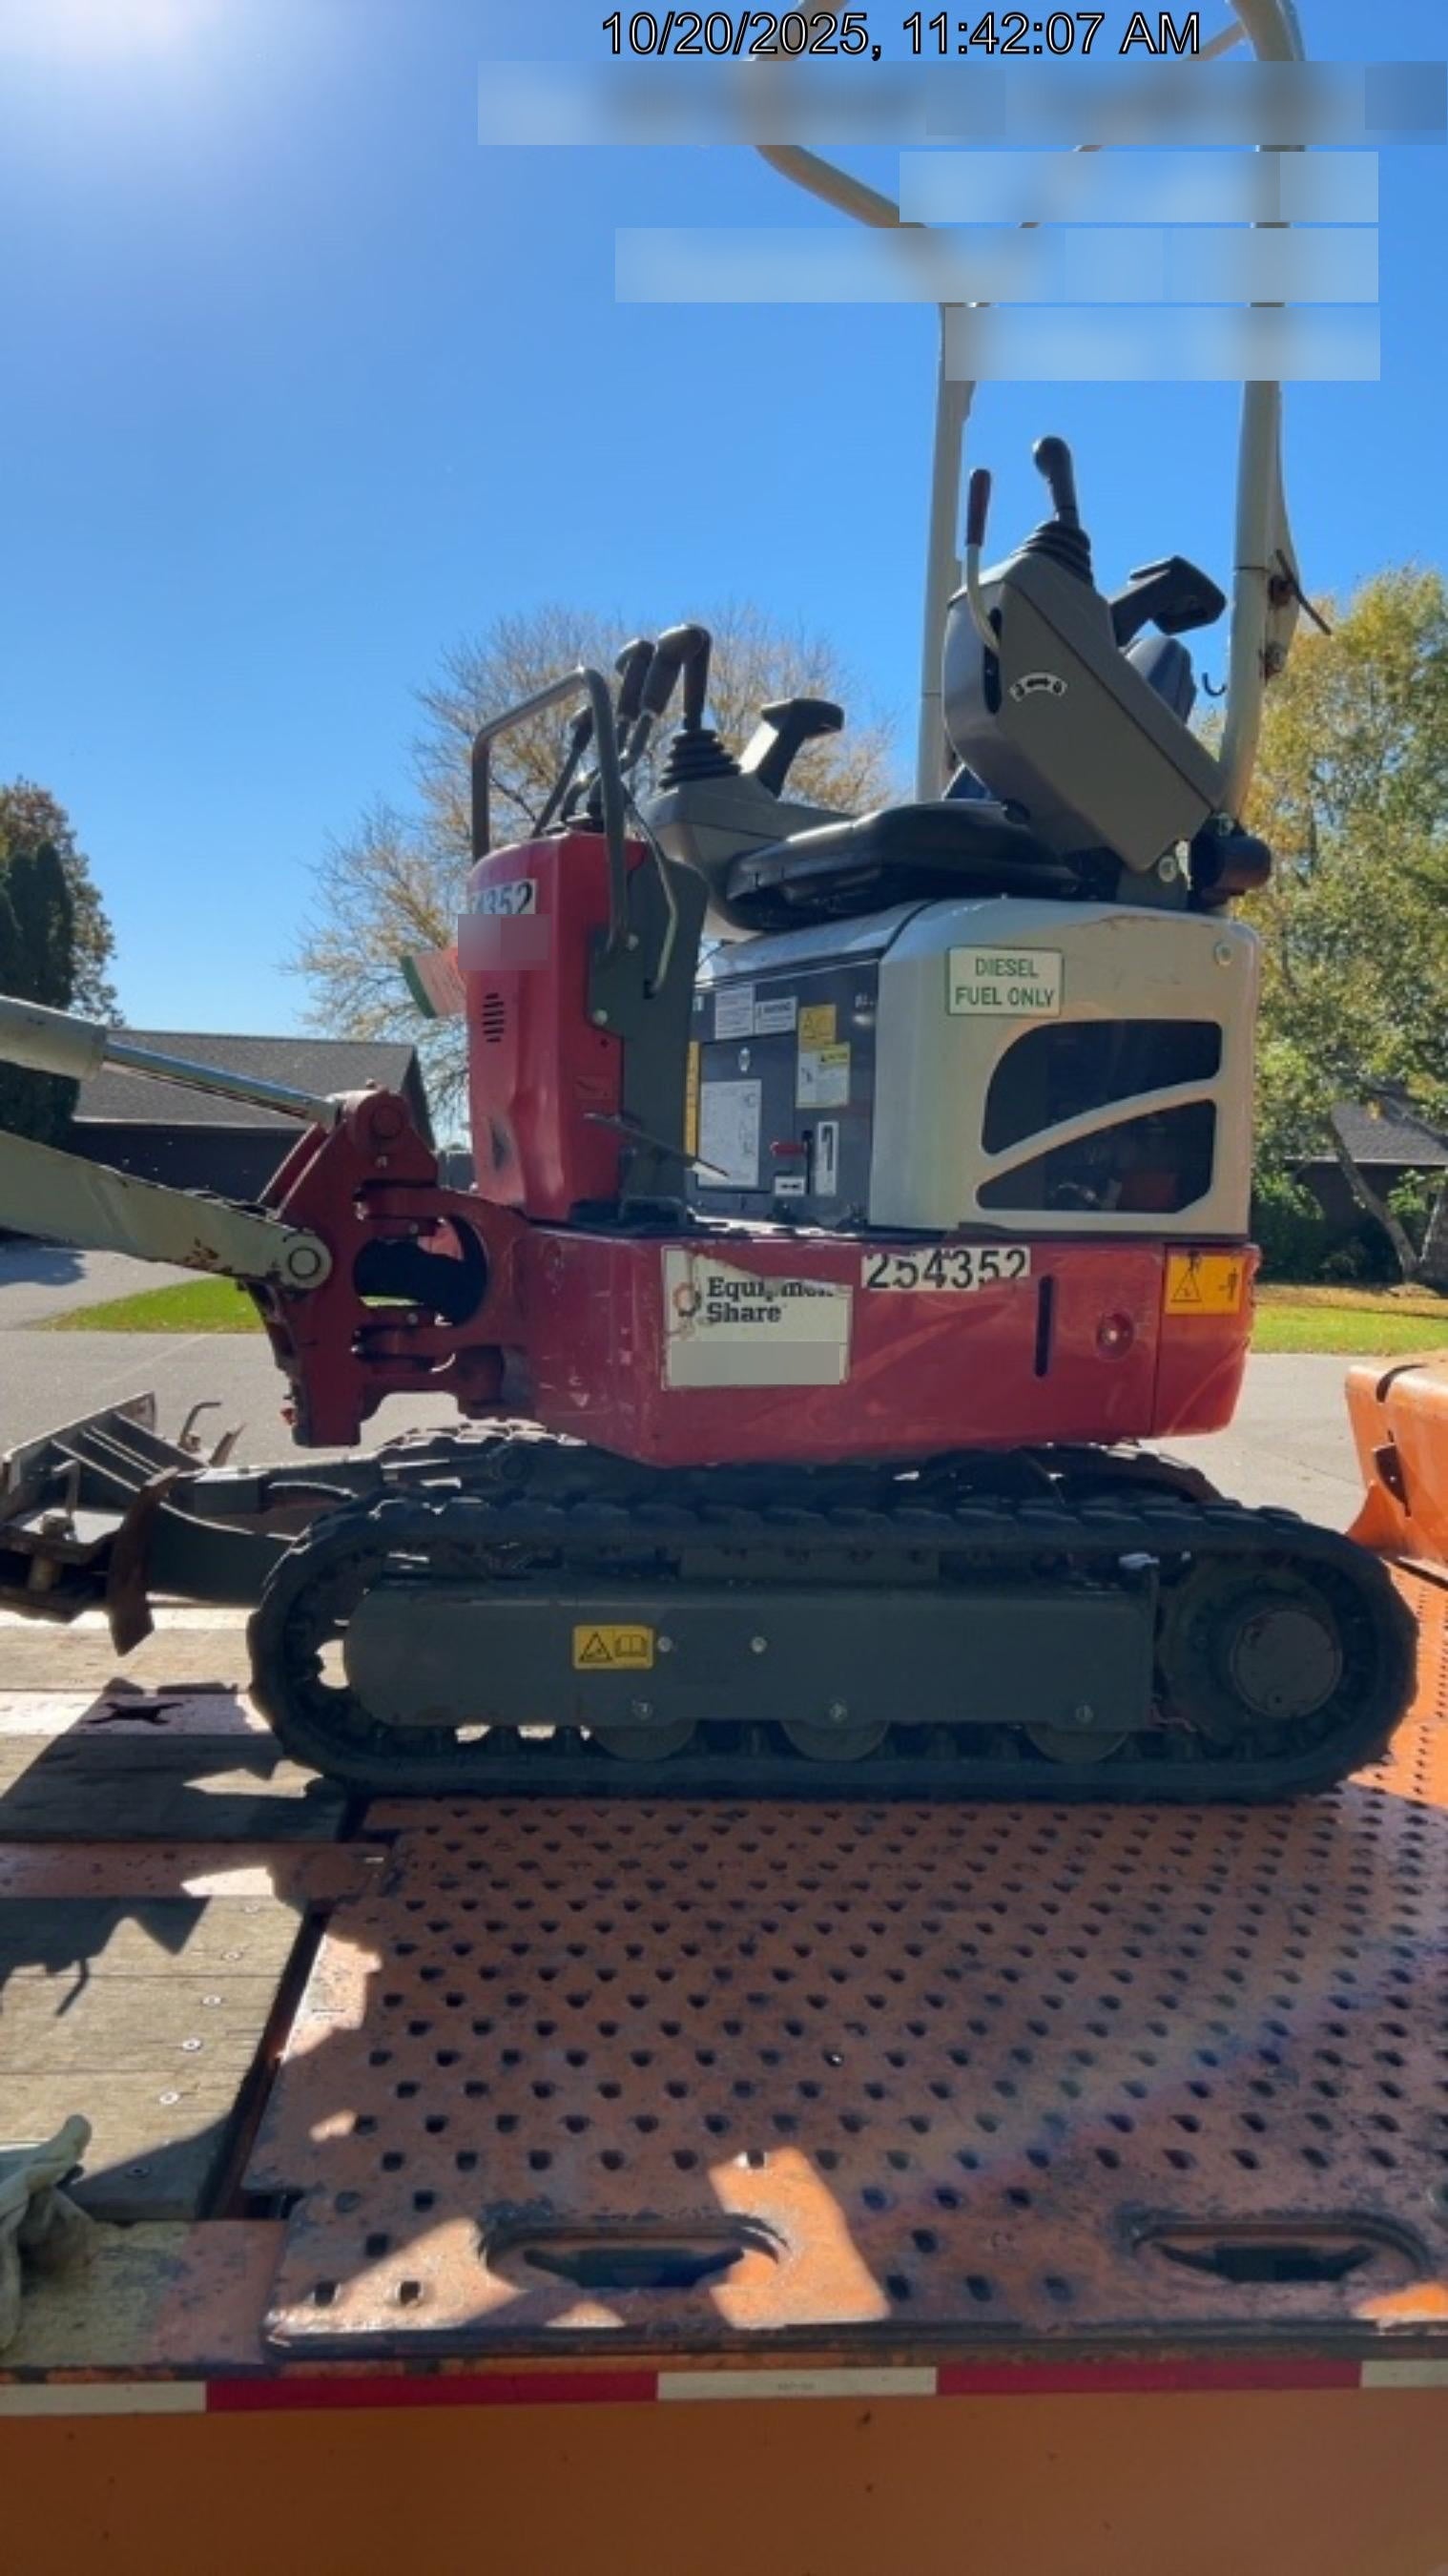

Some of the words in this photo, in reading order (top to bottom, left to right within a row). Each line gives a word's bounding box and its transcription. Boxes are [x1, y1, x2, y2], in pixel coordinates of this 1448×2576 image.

[975, 958, 1040, 978] DIESEL
[955, 987, 1003, 1006] FUEL
[1007, 987, 1056, 1008] ONLY
[867, 1248, 1025, 1289] 254352
[706, 1301, 782, 1323] Share
